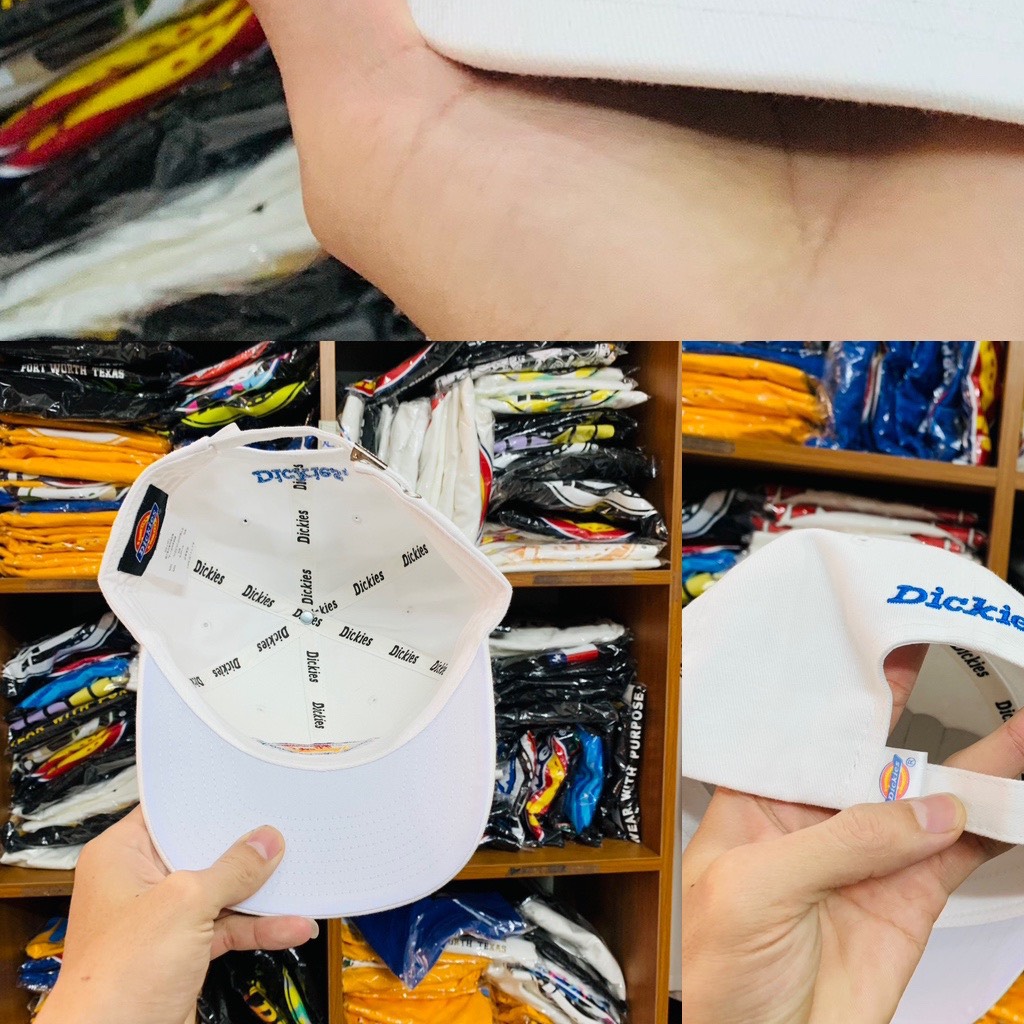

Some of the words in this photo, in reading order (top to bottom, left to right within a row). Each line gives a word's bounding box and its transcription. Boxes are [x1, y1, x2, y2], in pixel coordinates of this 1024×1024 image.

[20, 363, 46, 373] FORT
[49, 363, 87, 376] WORTH
[92, 366, 125, 379] TEXAS
[296, 510, 310, 544] Dickies
[193, 559, 225, 585] Dickies
[242, 584, 275, 608] Dickies
[300, 569, 314, 605] Dickies
[353, 571, 384, 596] Dickies
[401, 544, 429, 568] Dickies
[256, 626, 290, 652] Dickies
[339, 626, 373, 647] Dickies
[389, 645, 420, 664] Dickies
[212, 657, 241, 677] Dickies
[306, 650, 321, 683] Dickies
[312, 701, 327, 729] Dickies
[620, 765, 637, 802] WITH
[629, 692, 645, 759] PURPOSE
